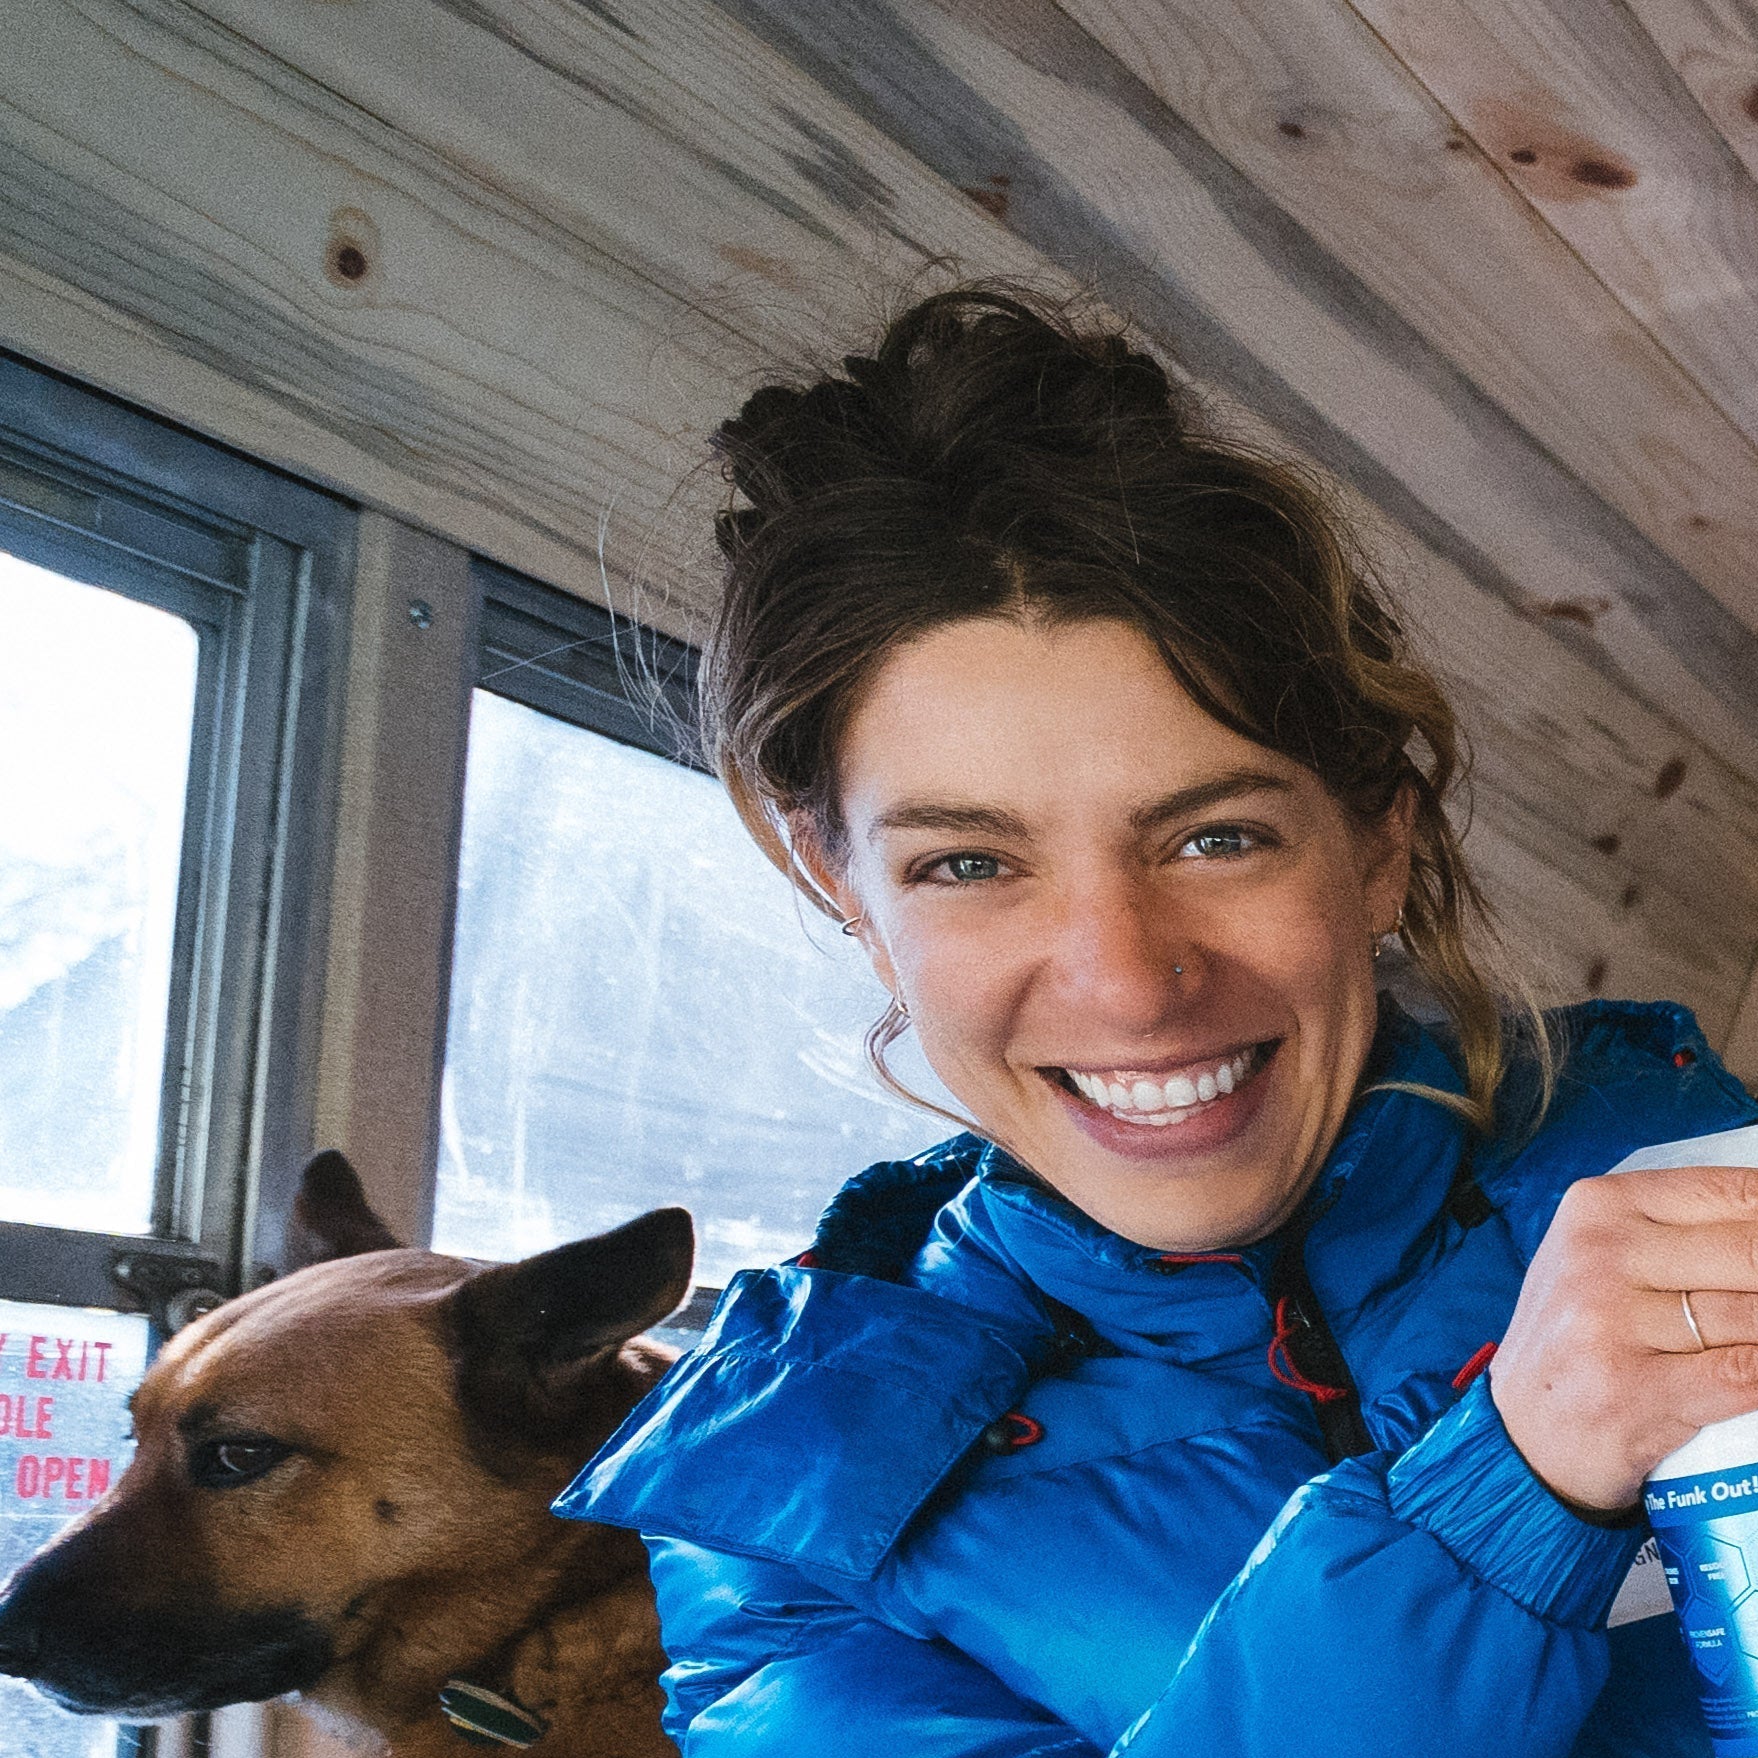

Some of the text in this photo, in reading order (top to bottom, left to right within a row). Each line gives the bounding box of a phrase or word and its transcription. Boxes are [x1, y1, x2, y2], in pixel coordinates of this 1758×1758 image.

[26, 1335, 113, 1383] EXIT
[16, 1454, 111, 1500] OPEN
[1646, 1492, 1666, 1511] The
[1667, 1485, 1708, 1509] Funk
